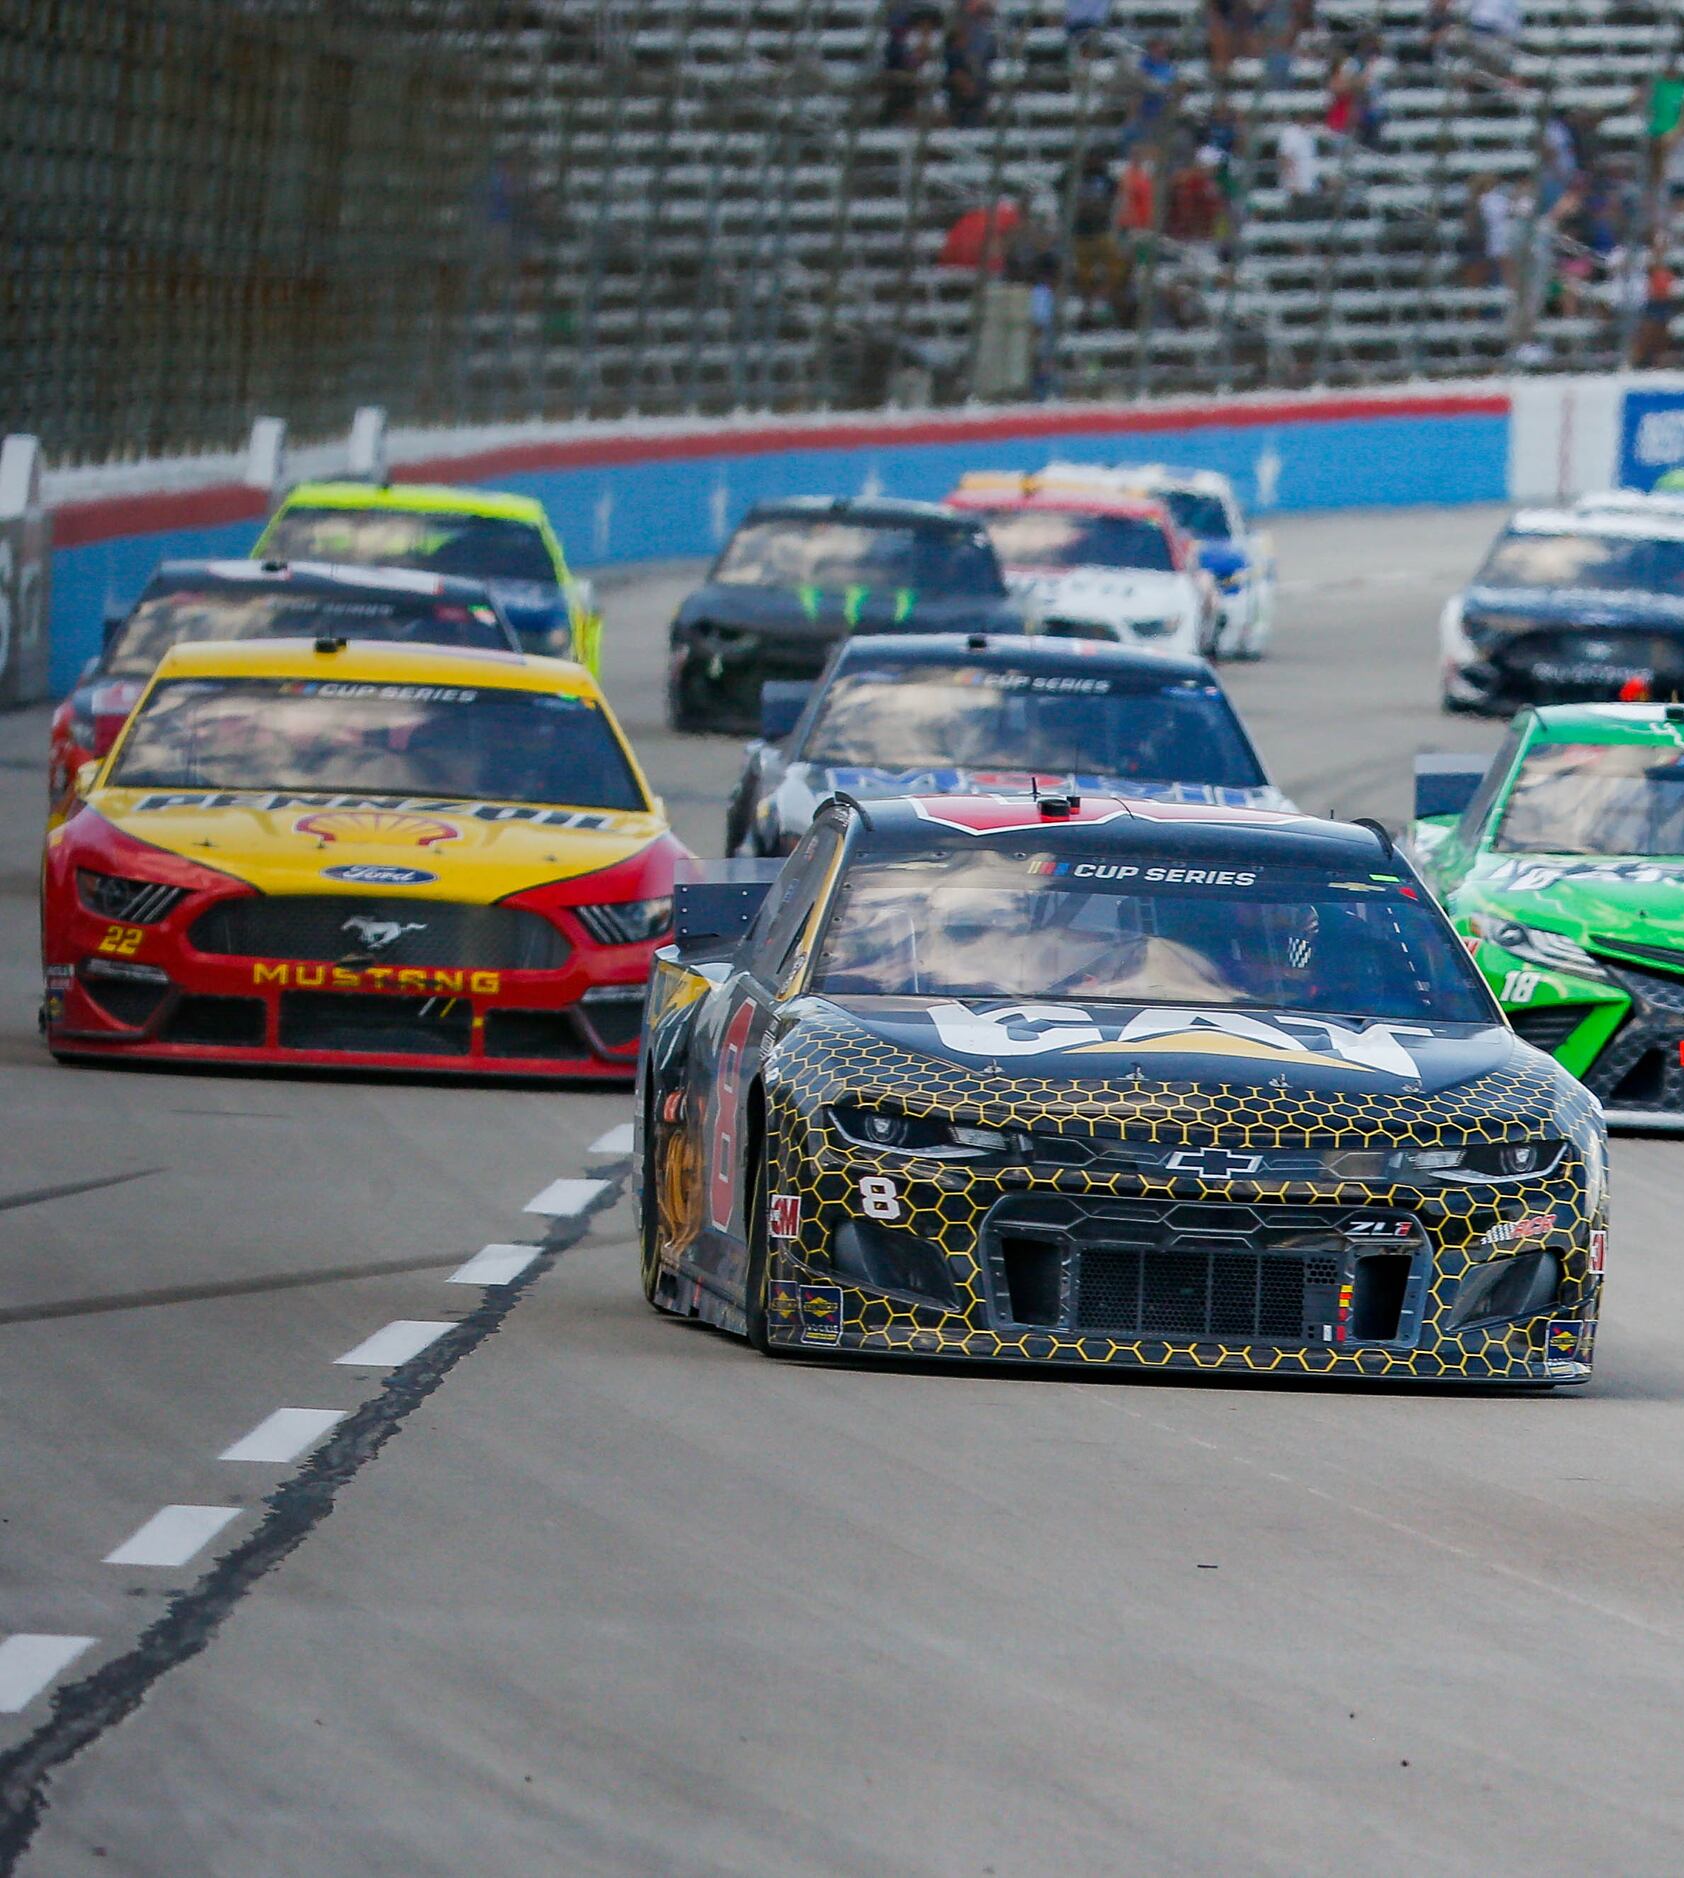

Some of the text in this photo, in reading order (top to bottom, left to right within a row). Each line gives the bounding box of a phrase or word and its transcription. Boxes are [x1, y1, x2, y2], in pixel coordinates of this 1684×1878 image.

[317, 683, 479, 705] CUP SERIES
[983, 672, 1111, 694] CUP SERIES
[342, 866, 416, 883] Ford
[1073, 863, 1257, 886] CUP SERIES
[99, 926, 144, 955] 22
[252, 962, 501, 994] MUSTANG
[1499, 970, 1541, 1003] 18
[926, 1000, 1434, 1079] CAT
[859, 1176, 900, 1219] 8
[771, 1198, 799, 1237] 3M
[1344, 1222, 1412, 1236] ZL1
